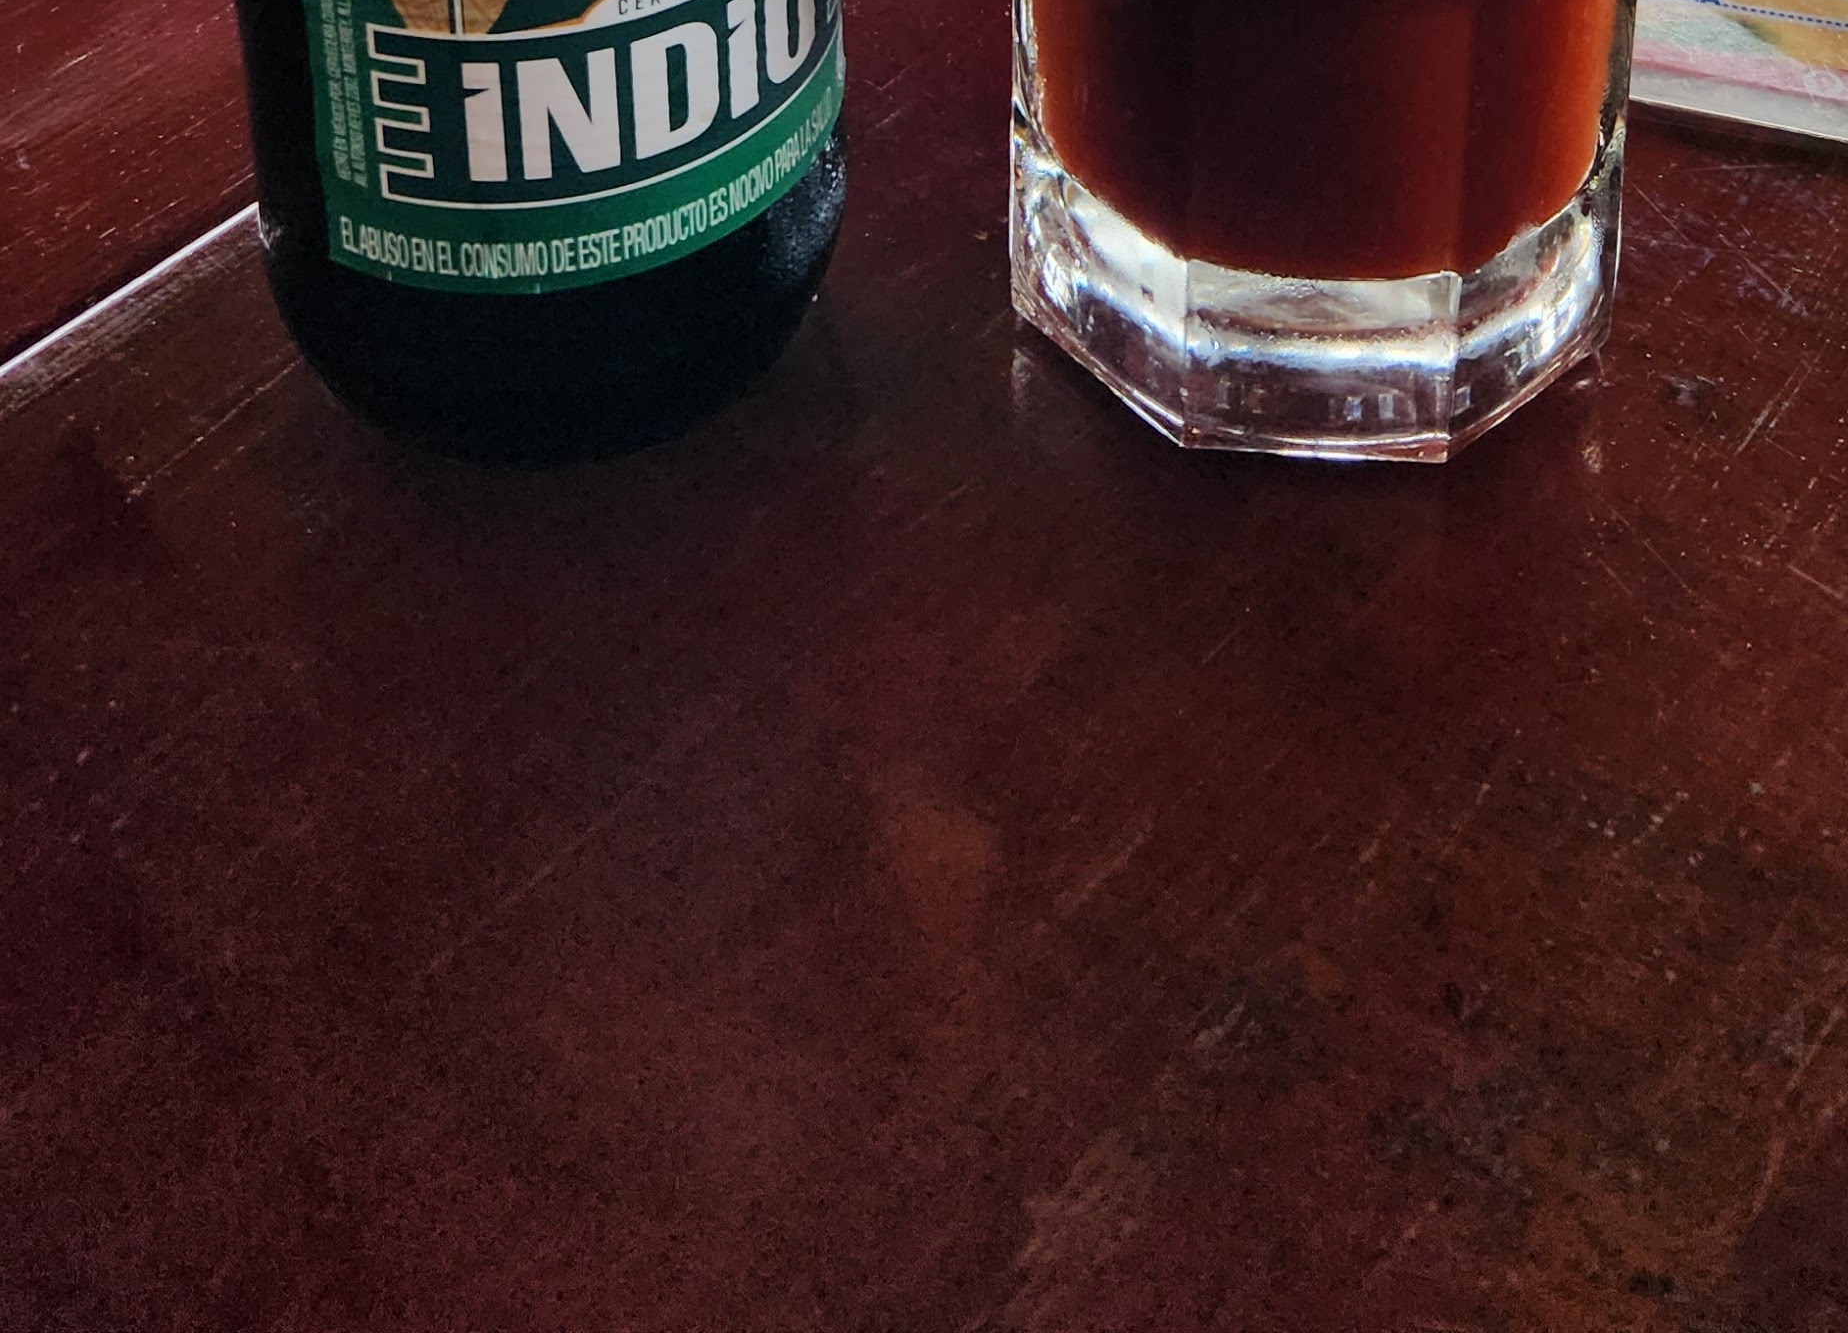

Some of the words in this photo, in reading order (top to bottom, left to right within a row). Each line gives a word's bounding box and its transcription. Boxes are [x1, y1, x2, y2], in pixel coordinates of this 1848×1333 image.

[340, 215, 359, 254] EL
[359, 223, 410, 269] ABUSO
[410, 237, 435, 274] EN
[436, 240, 460, 276] EL
[460, 241, 548, 279] CONSUMO
[551, 237, 577, 274] DE
[577, 228, 621, 270] ESTE
[623, 198, 708, 261] PRODUCTO
[708, 187, 729, 228] ES
[729, 155, 774, 216] NOCIVO
[775, 130, 801, 183] PARA
